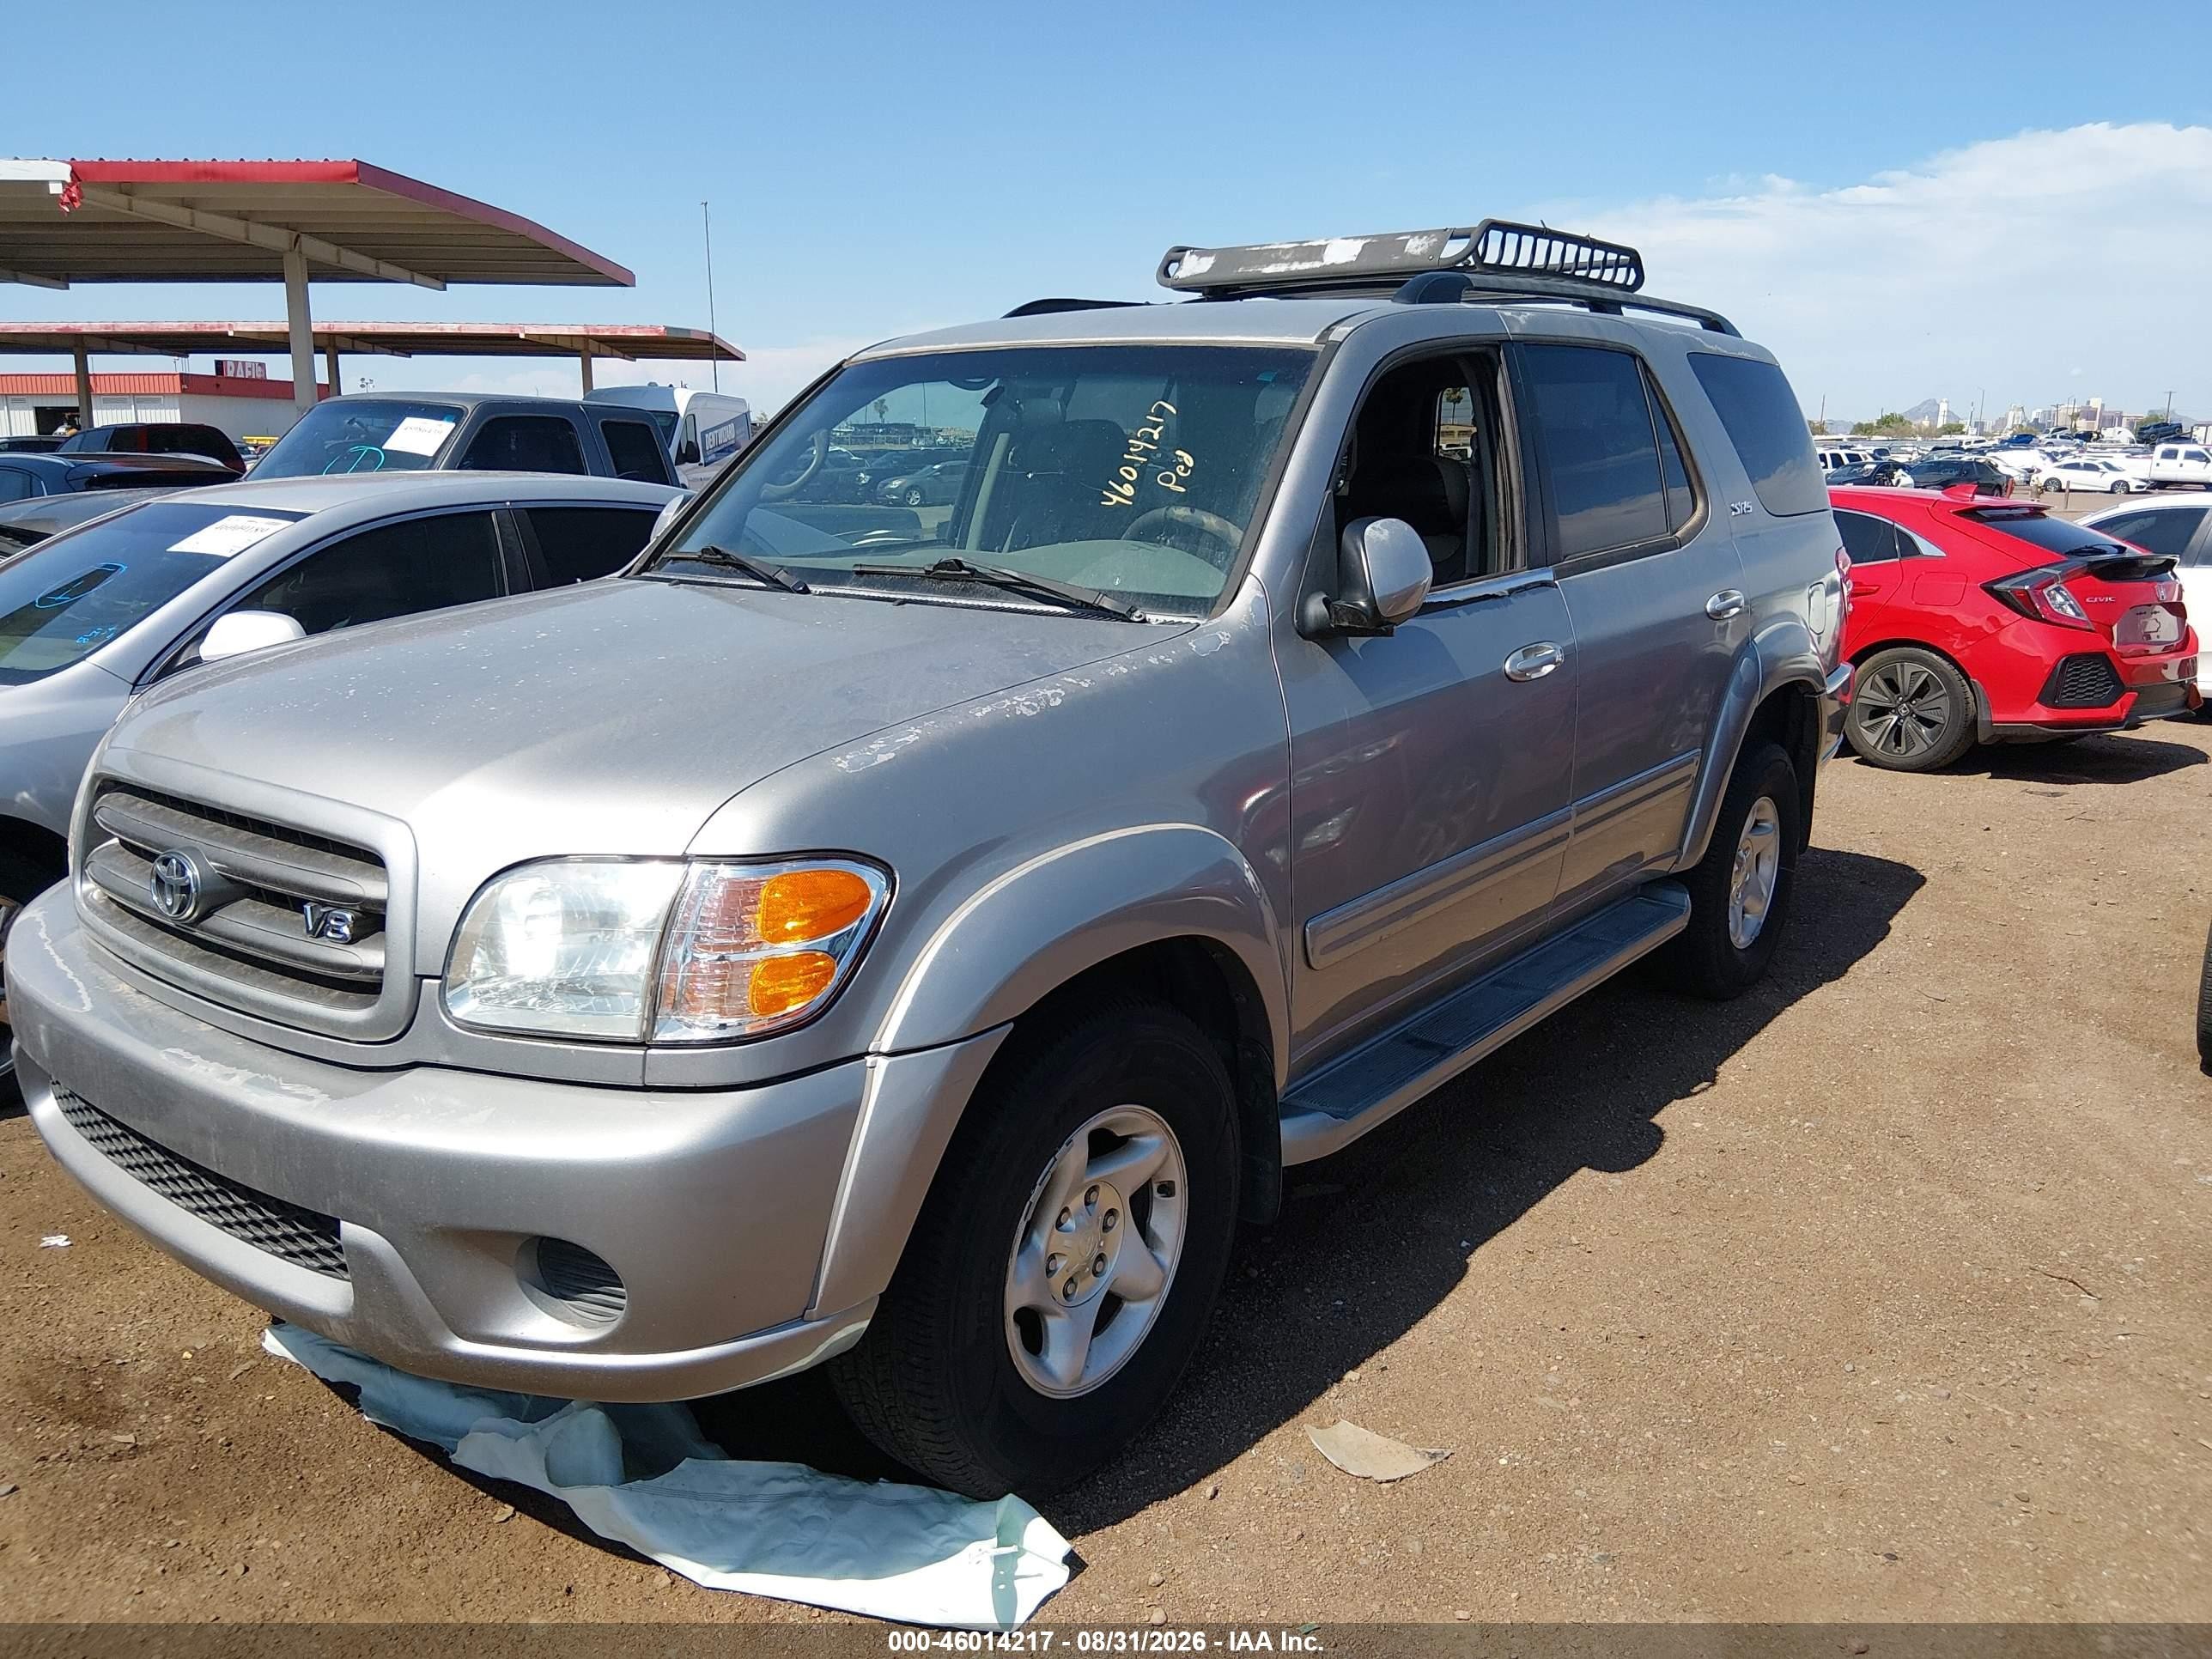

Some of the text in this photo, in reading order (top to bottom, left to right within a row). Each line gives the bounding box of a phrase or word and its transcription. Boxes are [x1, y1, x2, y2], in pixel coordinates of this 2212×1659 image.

[1100, 400, 1177, 506] 46014217
[1730, 501, 1753, 516] SR5
[303, 902, 356, 945] V8
